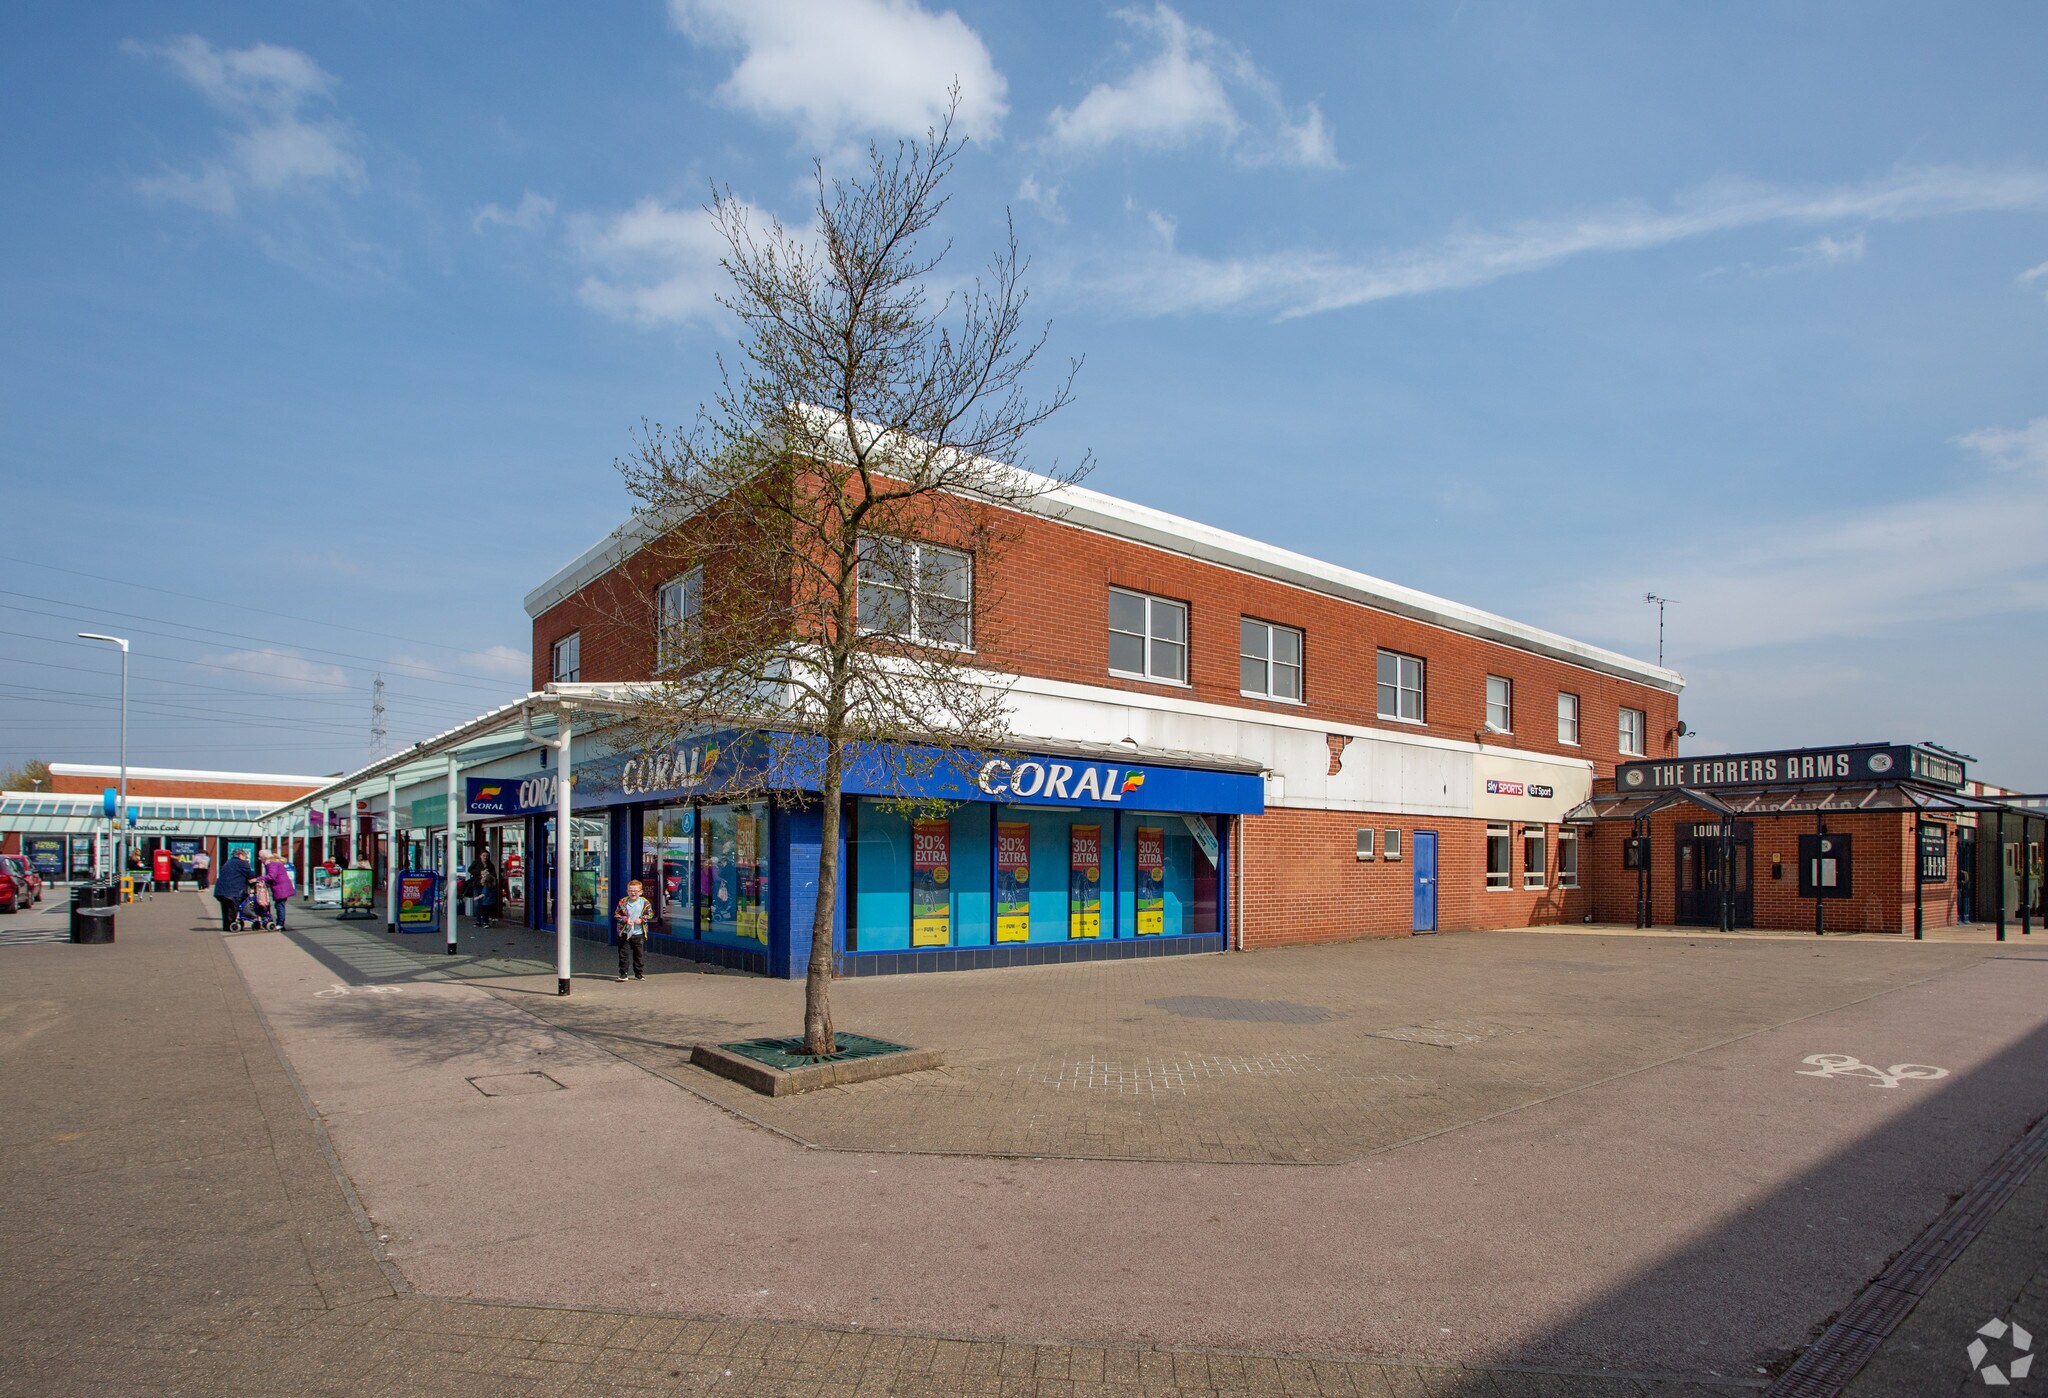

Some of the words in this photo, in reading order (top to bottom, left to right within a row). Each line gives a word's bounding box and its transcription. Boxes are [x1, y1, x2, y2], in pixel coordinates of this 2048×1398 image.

[622, 747, 703, 795] CORAL
[1653, 765, 1685, 787] THE
[1693, 758, 1778, 784] FERRERS
[1787, 753, 1849, 779] ARMS
[978, 759, 1122, 802] CORAL
[519, 774, 559, 809] CORA
[1487, 780, 1498, 794] sky
[1498, 783, 1523, 795] SPORTS
[1530, 786, 1539, 795] BT
[1539, 787, 1552, 797] Sport
[470, 802, 504, 810] CORAL
[160, 824, 180, 832] Cook
[916, 835, 945, 850] 30%
[999, 837, 1026, 852] 30%
[1073, 839, 1097, 853] 30%
[1139, 841, 1160, 854] 30%
[915, 850, 948, 862] EXTRA
[999, 852, 1028, 862] EXTRA
[1072, 853, 1099, 863] EXTRA
[1138, 854, 1162, 863] EXTRA
